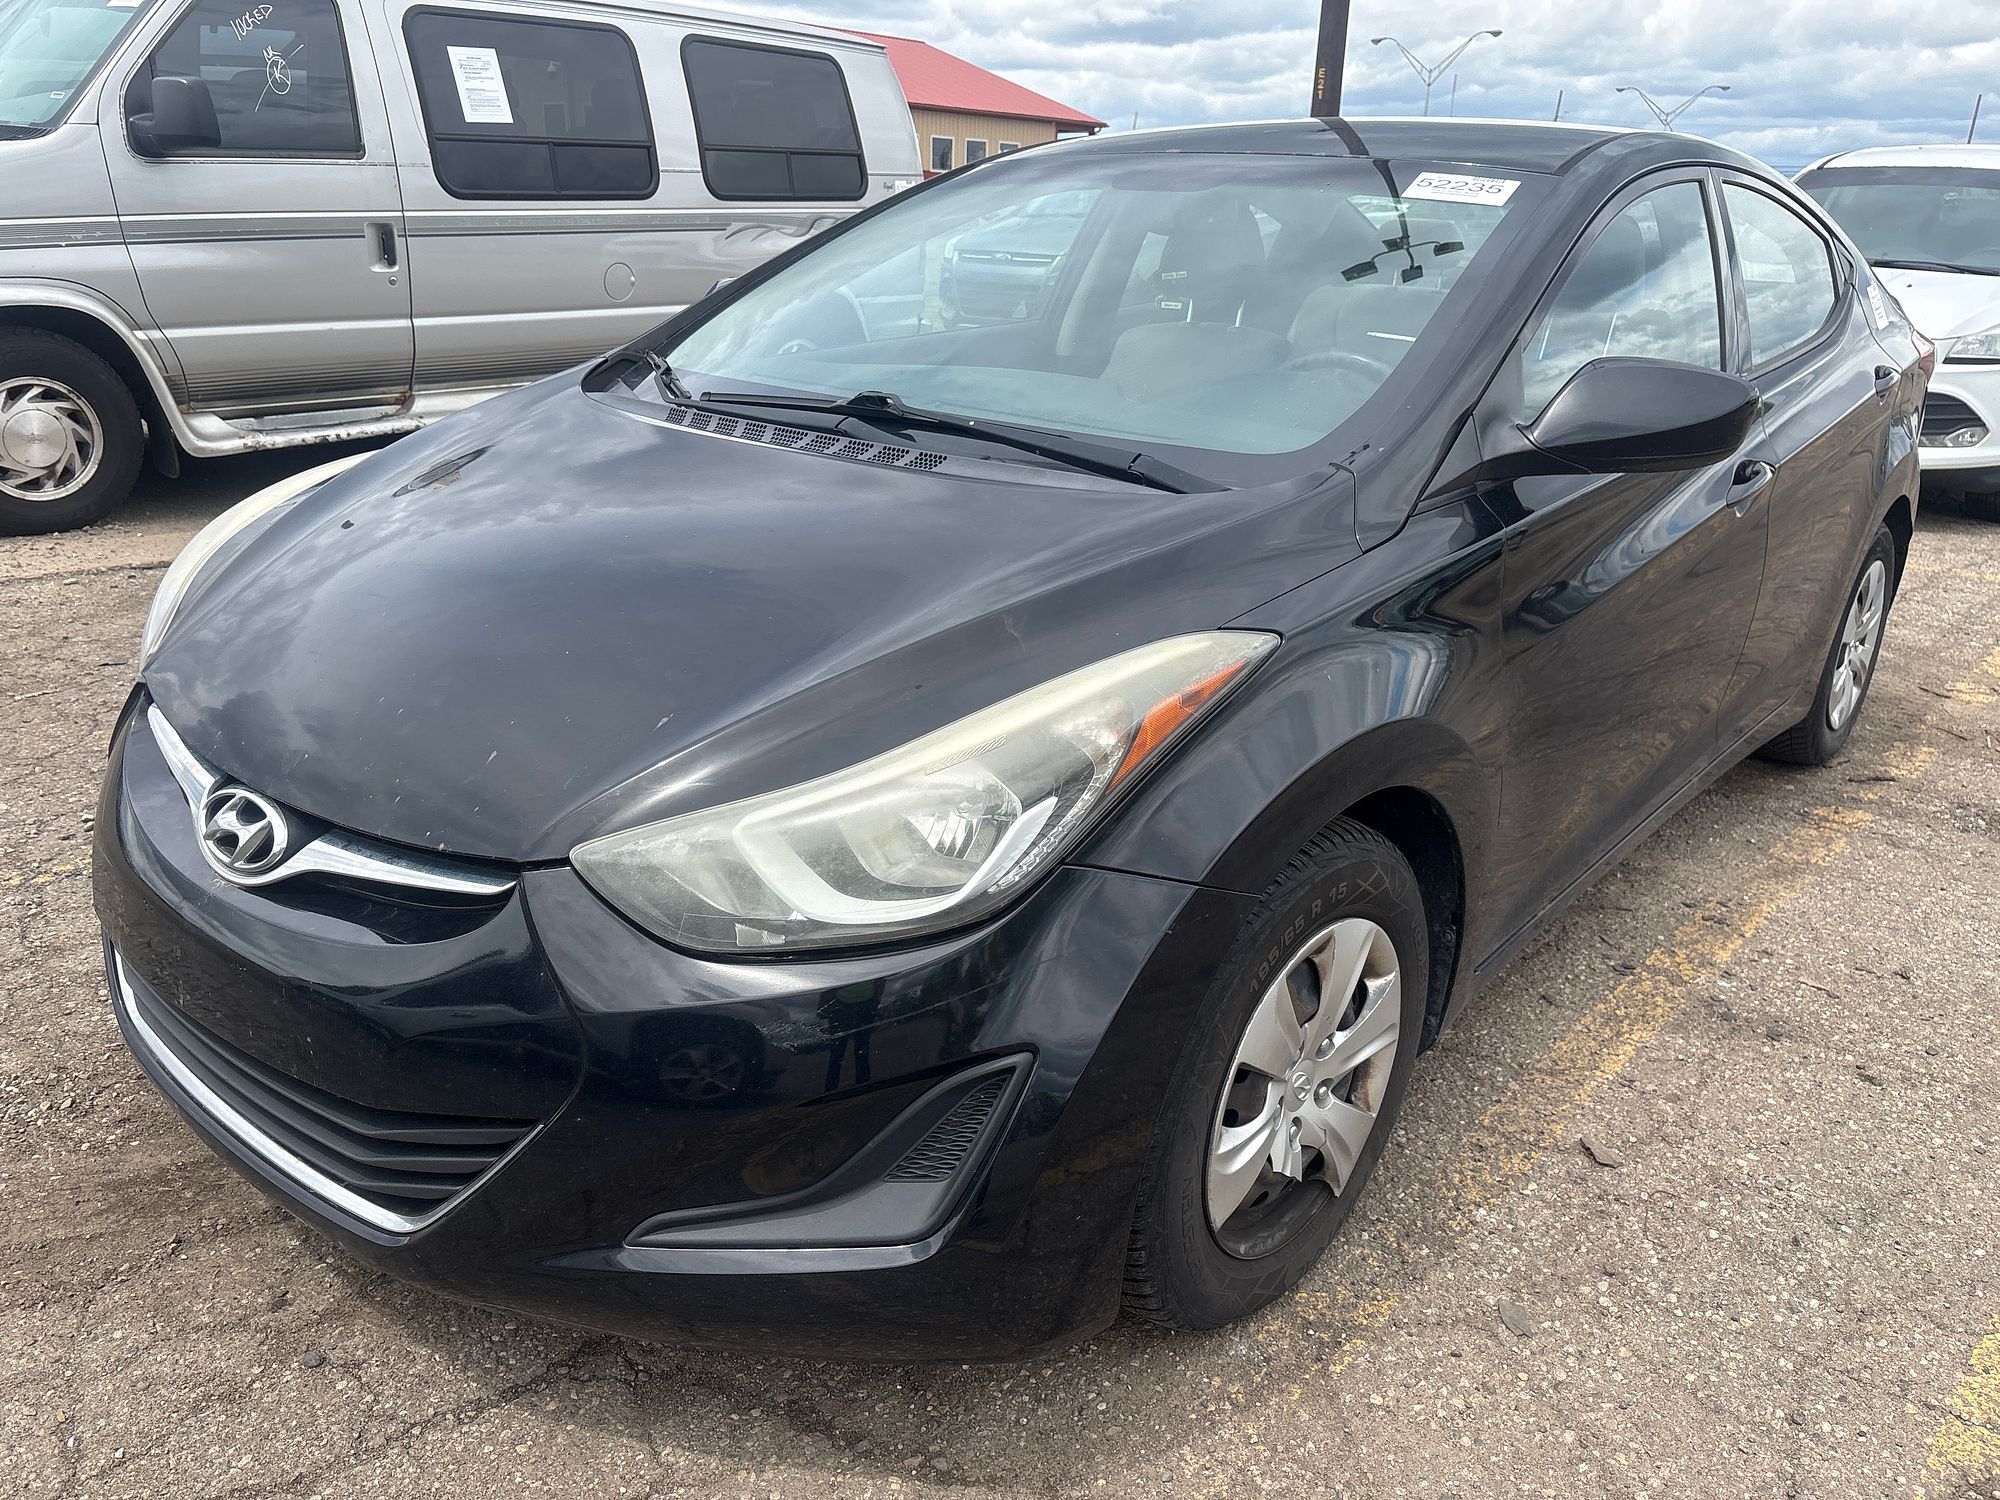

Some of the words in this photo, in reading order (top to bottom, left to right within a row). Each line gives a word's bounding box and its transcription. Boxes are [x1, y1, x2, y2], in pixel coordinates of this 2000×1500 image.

[1317, 67, 1326, 100] E21
[1416, 178, 1505, 195] 52235
[1250, 914, 1306, 993] 195/65
[1311, 899, 1322, 919] R
[1329, 881, 1348, 904] 15
